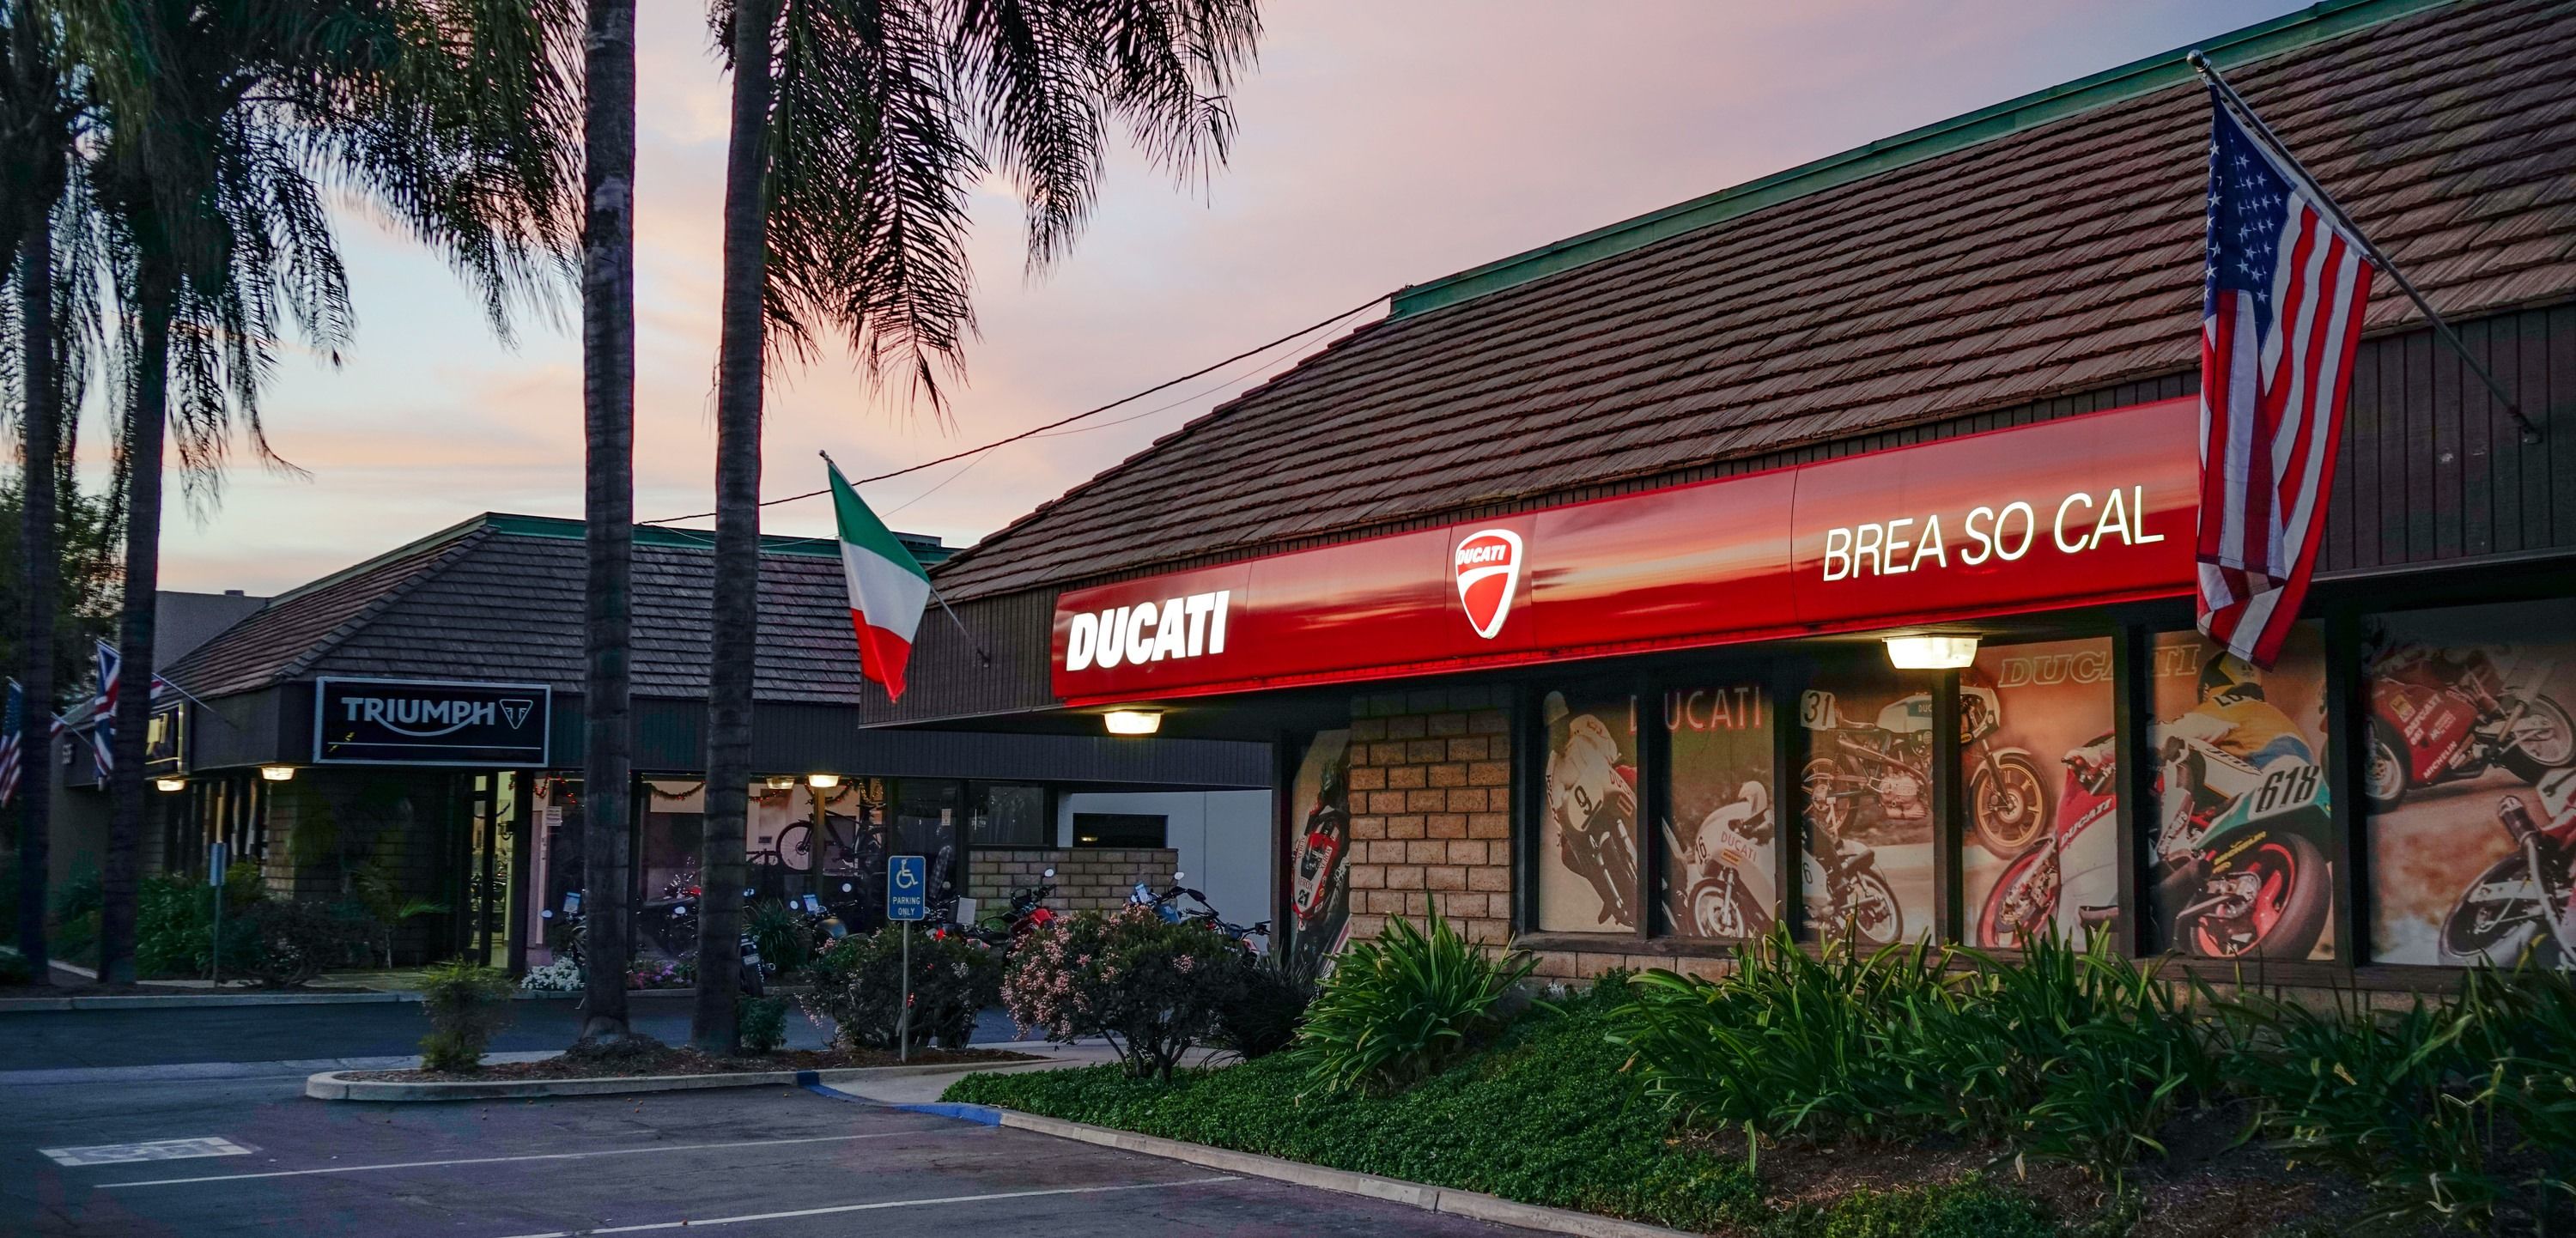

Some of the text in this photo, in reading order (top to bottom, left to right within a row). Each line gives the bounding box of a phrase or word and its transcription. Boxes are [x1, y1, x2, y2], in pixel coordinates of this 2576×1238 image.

[1823, 485, 2165, 582] BREA SO CAL
[1456, 544, 1506, 566] DUCATI
[1066, 590, 1230, 671] DUCATI
[341, 697, 495, 736] TRIUMPH
[1804, 693, 1832, 726] 31
[2423, 741, 2458, 780] MICHELIN
[1574, 785, 1593, 815] 9
[2256, 766, 2320, 813] 618
[2060, 798, 2112, 847] DUCATI
[1695, 836, 1707, 865] 16
[1721, 830, 1757, 862] DUCATI
[893, 896, 920, 905] PARKING
[898, 907, 915, 916] ONLY
[1297, 889, 1310, 907] 21
